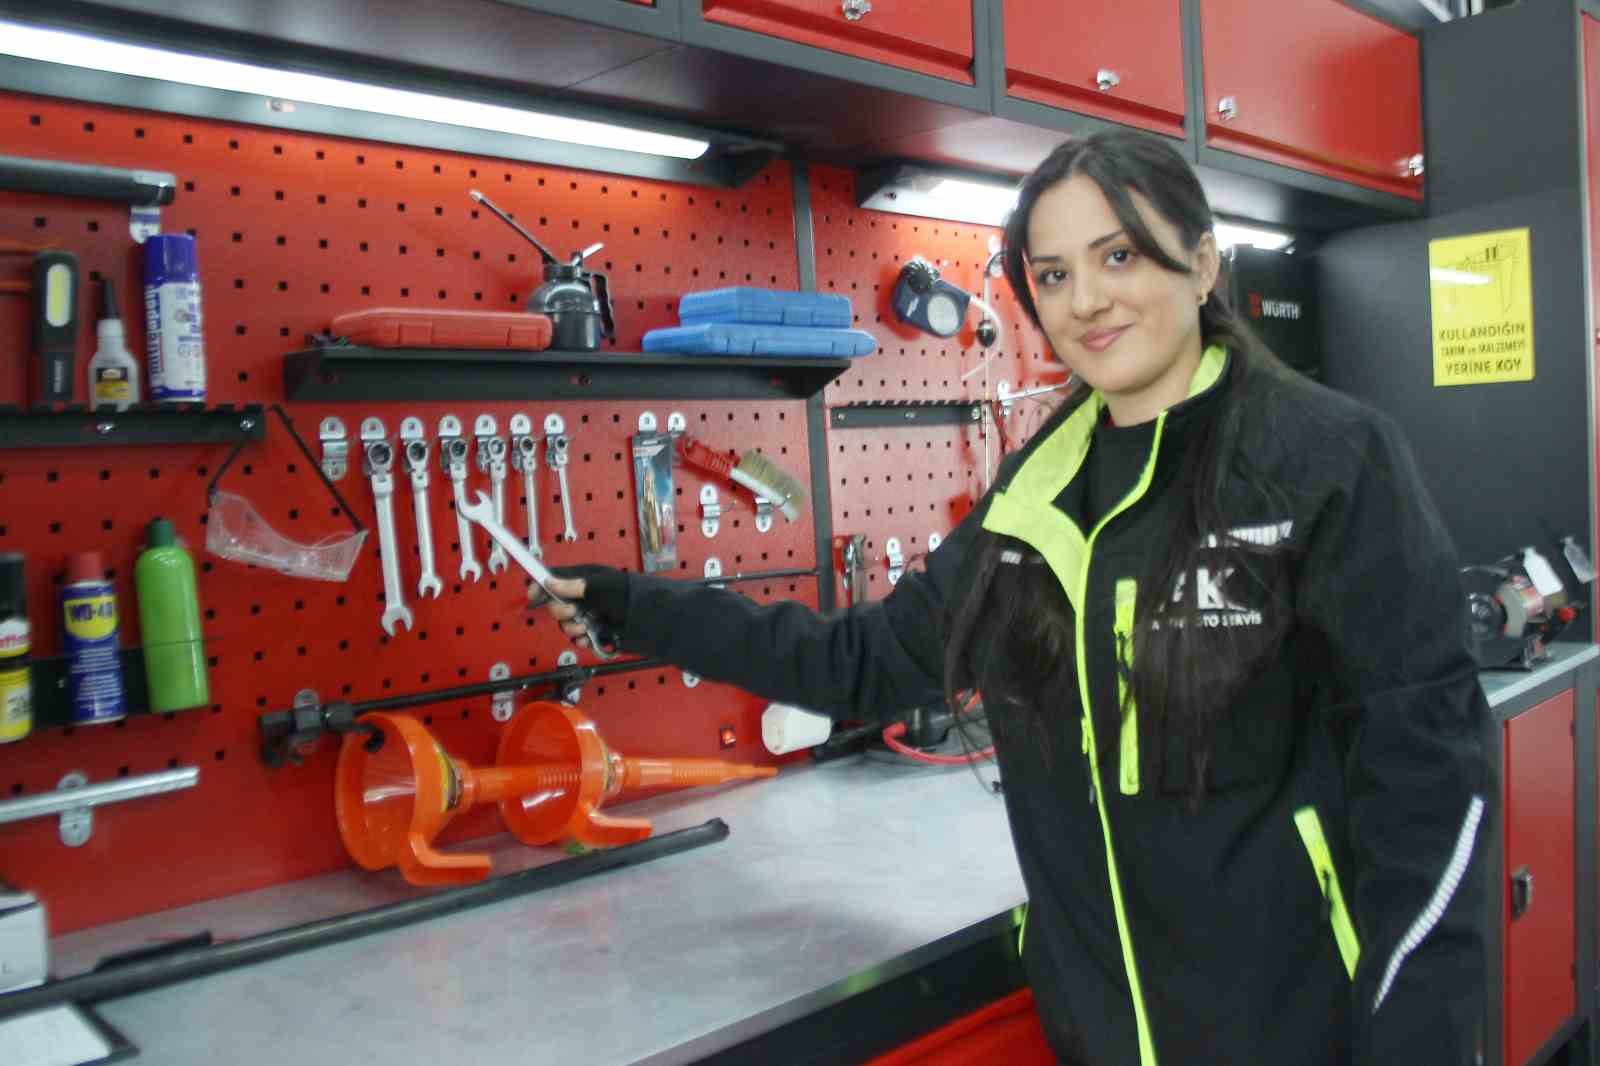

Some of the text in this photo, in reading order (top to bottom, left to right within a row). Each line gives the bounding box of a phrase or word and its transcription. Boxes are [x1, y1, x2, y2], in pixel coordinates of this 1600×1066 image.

[1439, 322, 1525, 341] KULLANDIĞIN
[1446, 358, 1522, 376] YERİNE KOY
